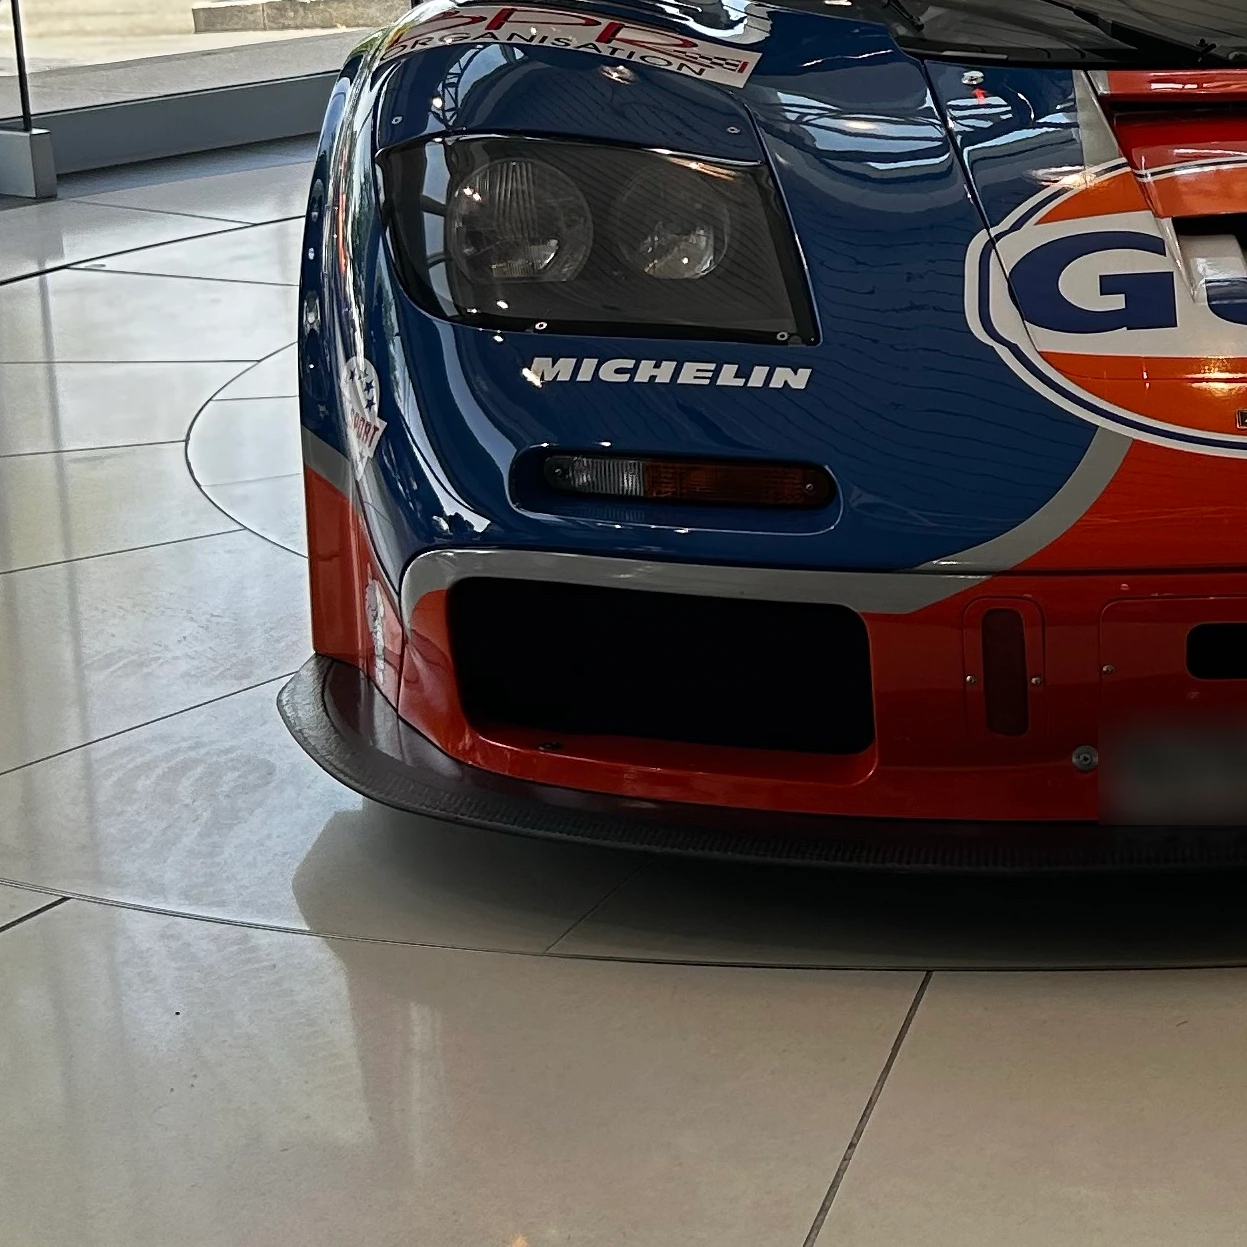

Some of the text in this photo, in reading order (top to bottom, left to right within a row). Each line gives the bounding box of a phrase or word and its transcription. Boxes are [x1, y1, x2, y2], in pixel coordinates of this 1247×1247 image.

[380, 32, 707, 75] ORGANISATION
[387, 7, 716, 70] BPR
[530, 357, 813, 390] MICHELIN
